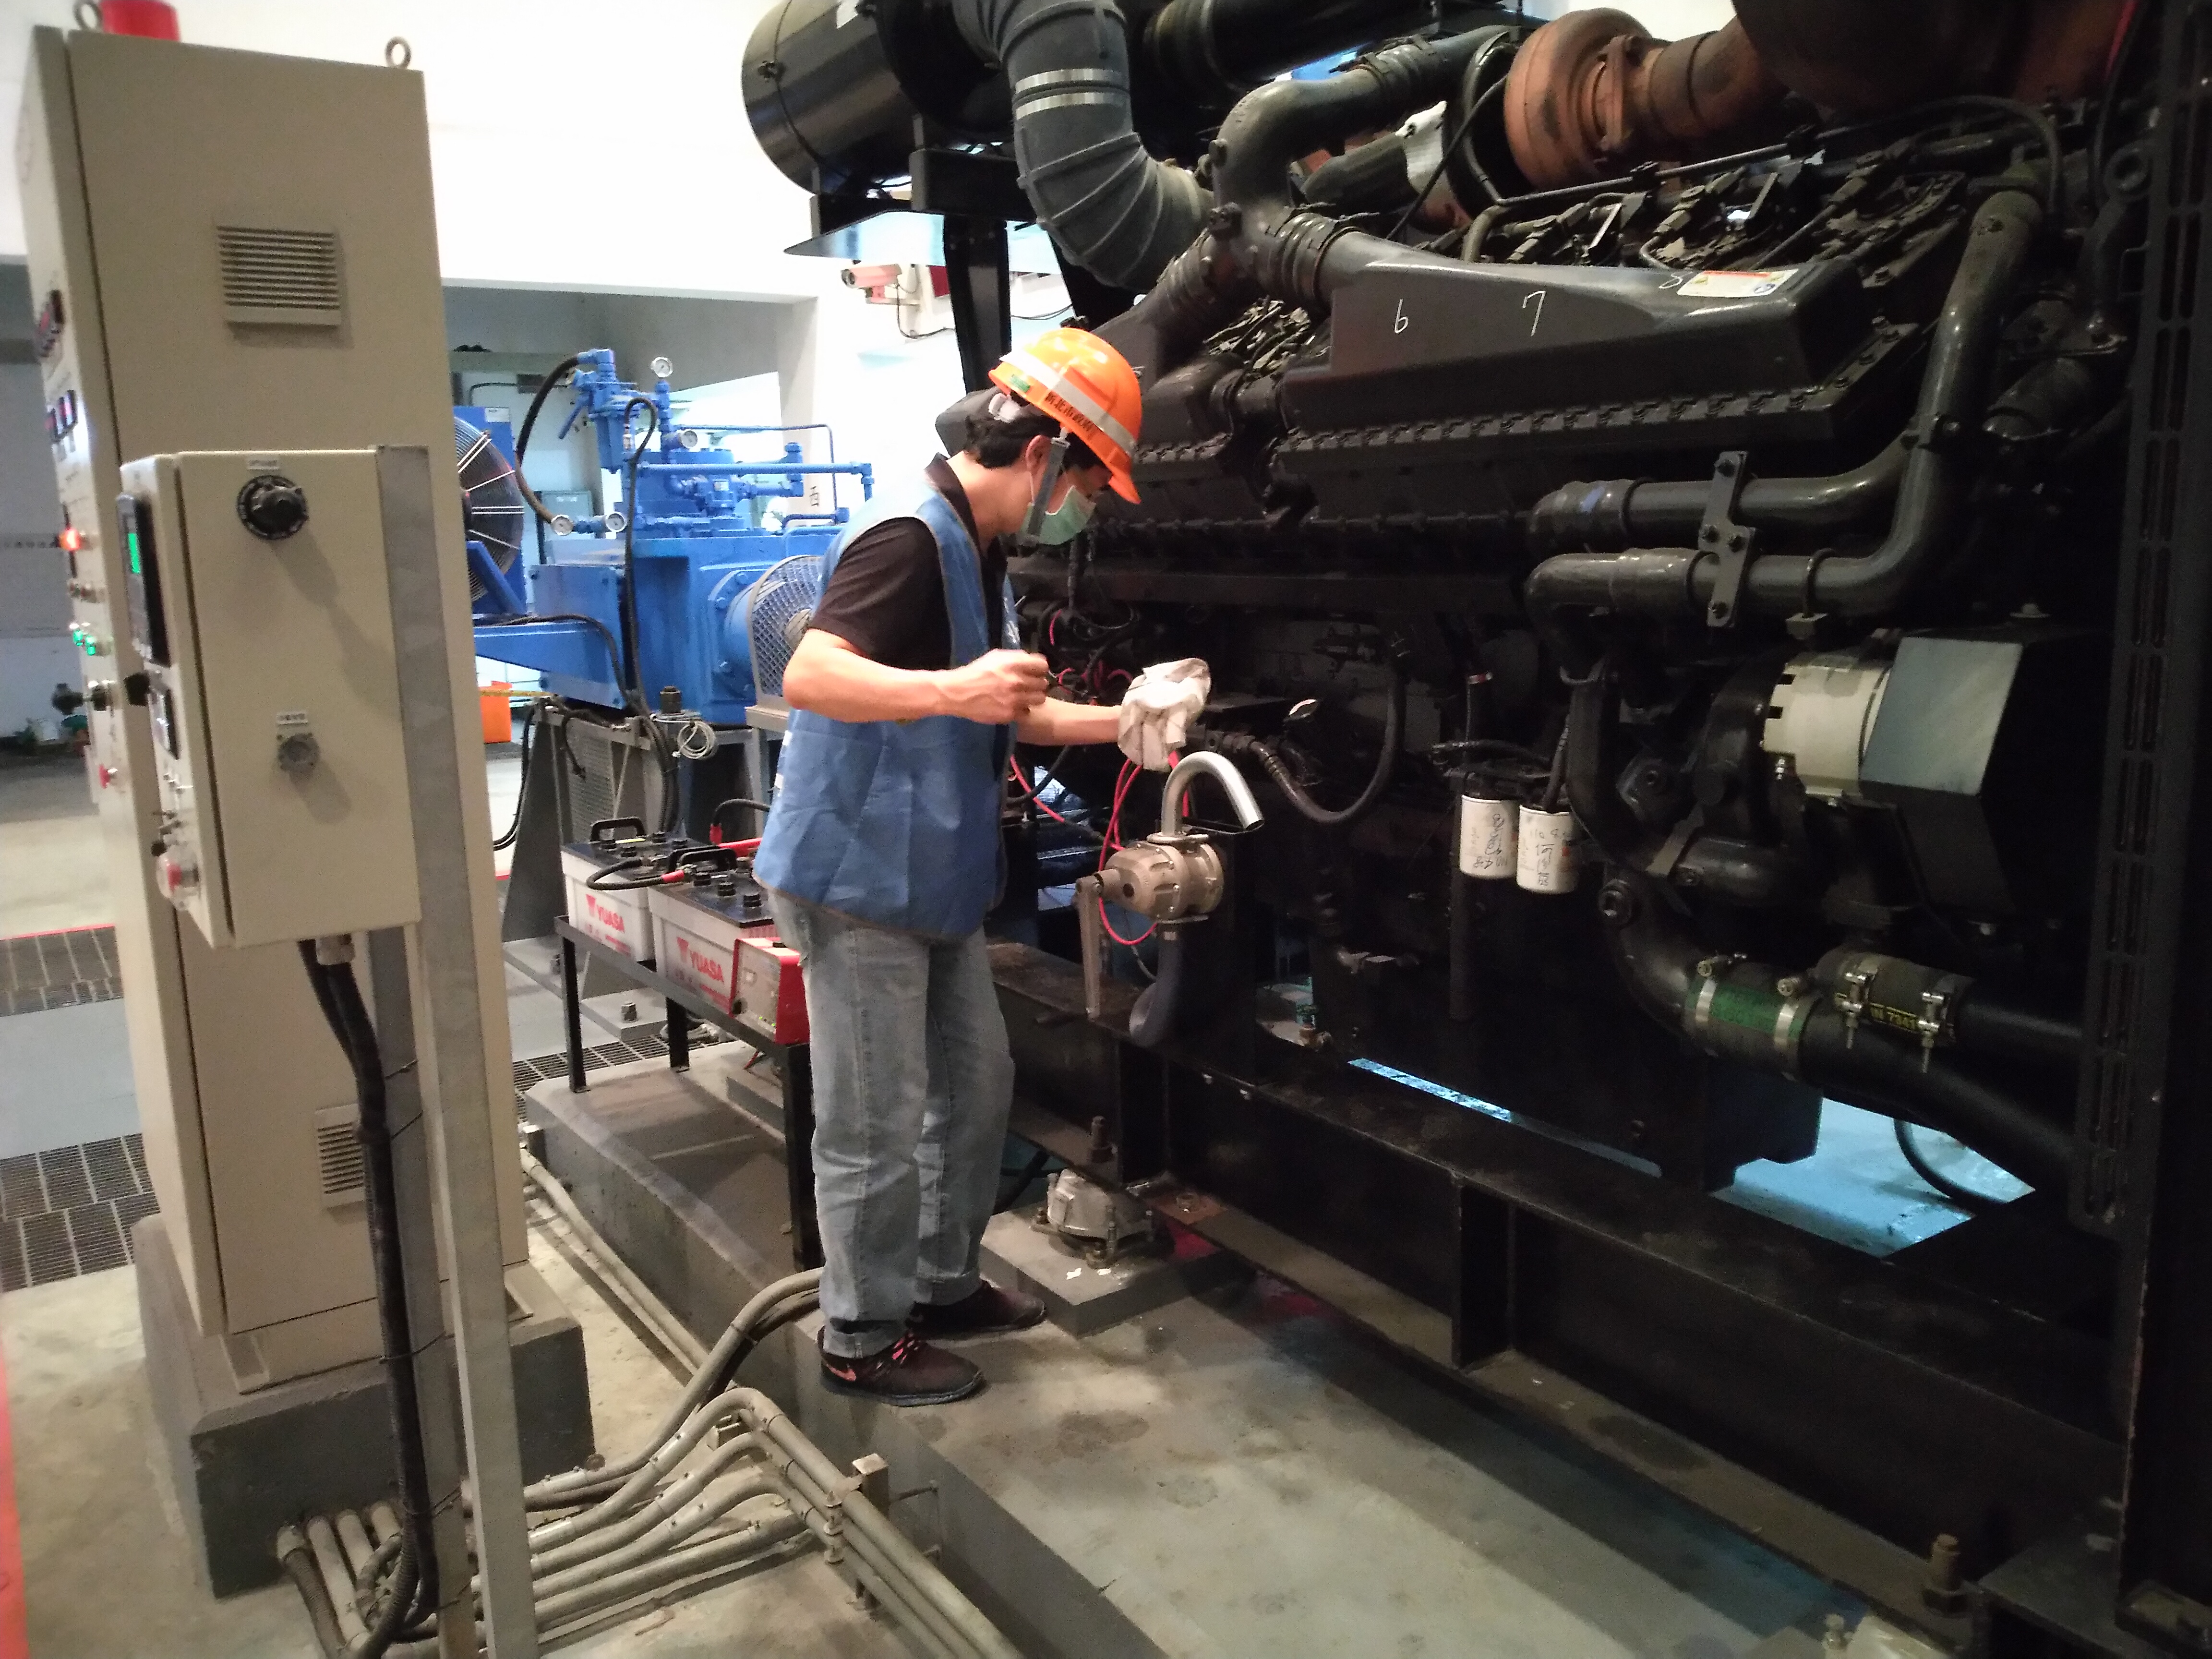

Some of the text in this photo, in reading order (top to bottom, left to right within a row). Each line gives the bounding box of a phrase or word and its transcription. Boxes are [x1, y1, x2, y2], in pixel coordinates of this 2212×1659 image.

[1394, 298, 1409, 334] 6
[1522, 290, 1546, 337] 7
[597, 905, 625, 934] YUASA
[690, 950, 724, 984] YUASA
